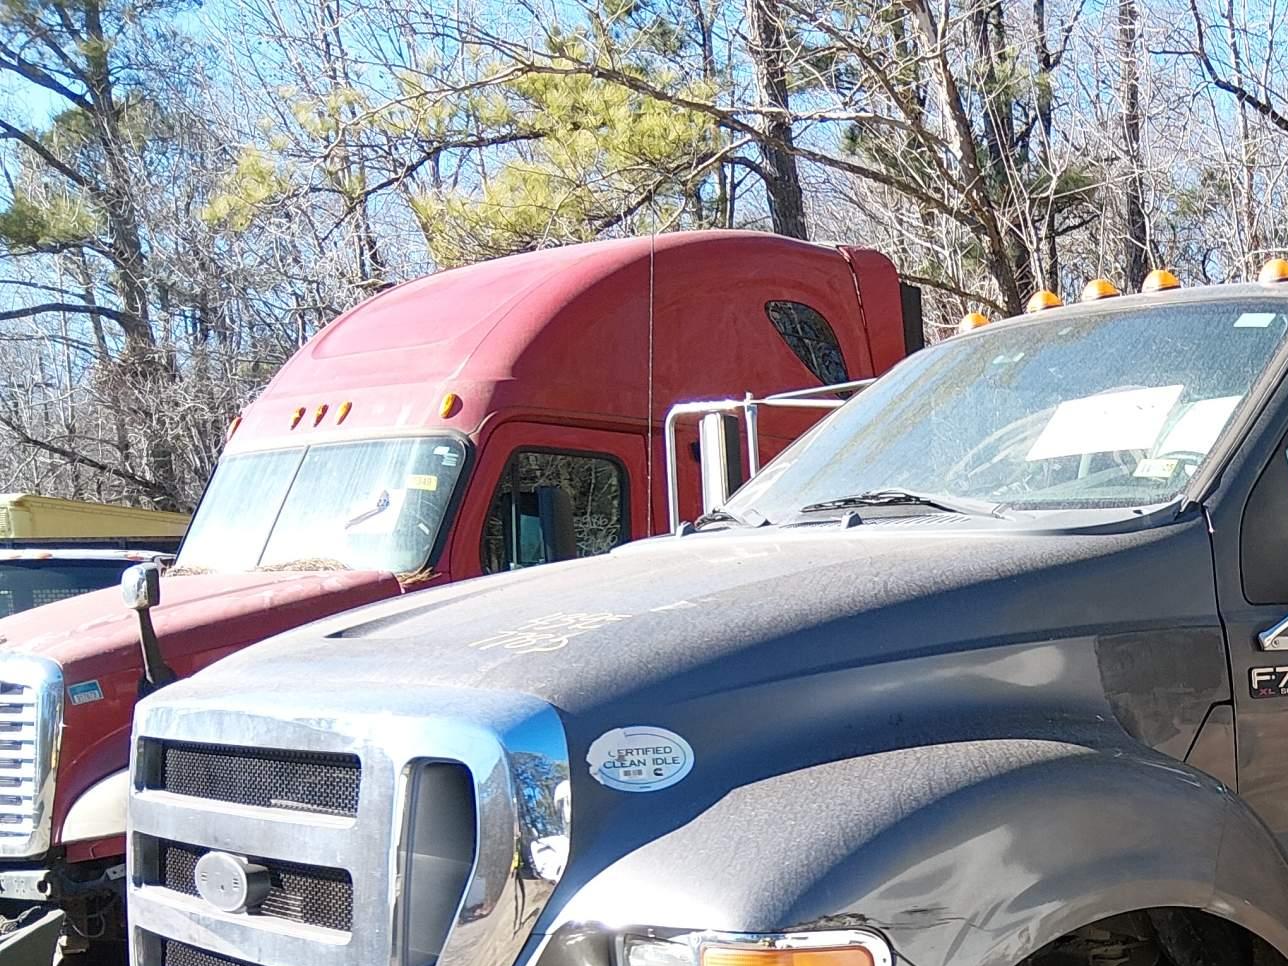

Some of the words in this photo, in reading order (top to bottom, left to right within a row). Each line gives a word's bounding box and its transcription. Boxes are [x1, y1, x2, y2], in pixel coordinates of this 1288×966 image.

[1259, 688, 1276, 696] XL
[603, 759, 646, 769] CLEAN
[652, 756, 680, 766] IDLE
